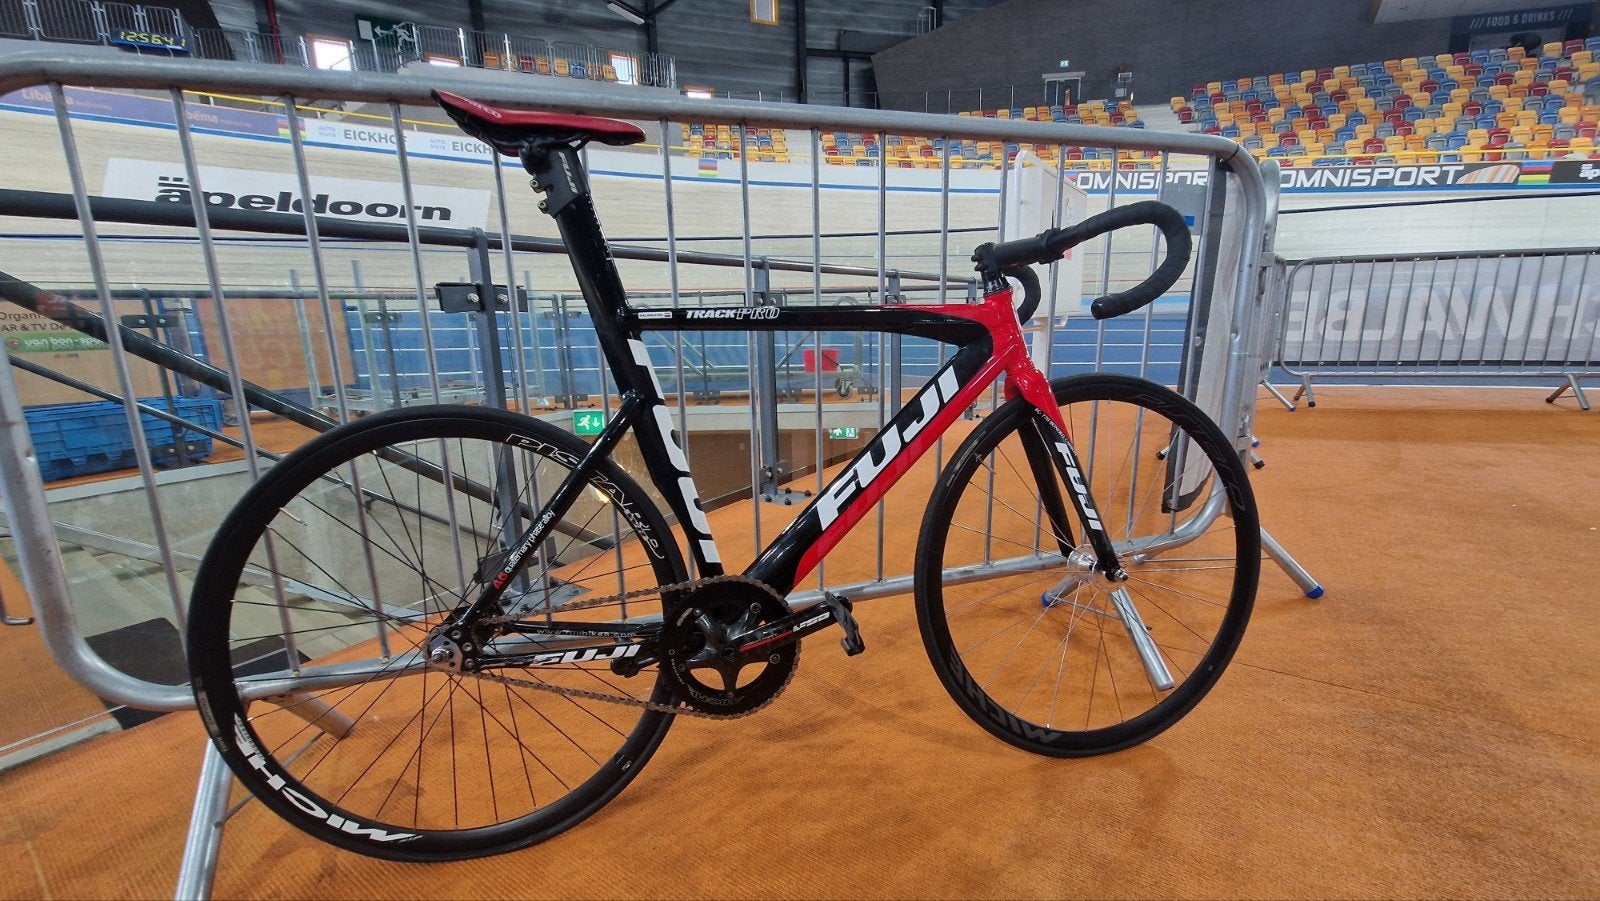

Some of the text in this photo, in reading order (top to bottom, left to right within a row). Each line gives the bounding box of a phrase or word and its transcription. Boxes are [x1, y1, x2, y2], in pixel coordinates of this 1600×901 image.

[1487, 15, 1510, 28] FOOD
[1521, 10, 1555, 25] DRINKS
[22, 89, 74, 105] Libea
[343, 129, 407, 146] EICKHO
[452, 141, 494, 155] EICKH
[1076, 171, 1210, 189] OMNISPOR
[1280, 165, 1465, 188] OMNISPORT
[816, 365, 960, 531] FUJI
[1054, 442, 1103, 531] FUJI
[233, 712, 420, 843] MICHE
